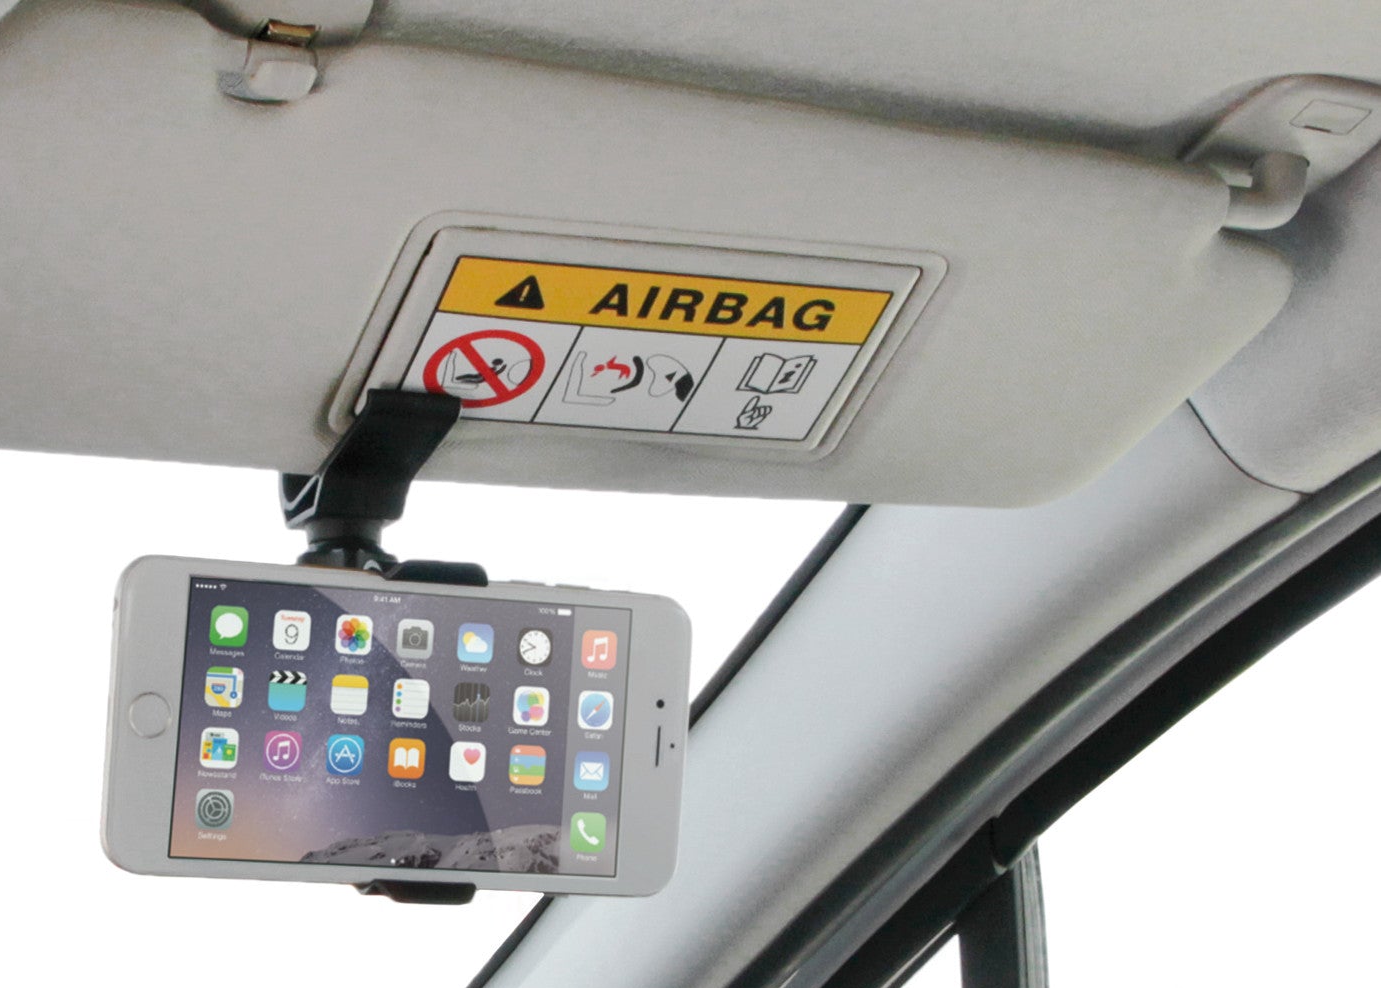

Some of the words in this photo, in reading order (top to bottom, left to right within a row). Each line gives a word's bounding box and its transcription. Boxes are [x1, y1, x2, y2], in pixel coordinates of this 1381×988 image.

[589, 282, 837, 332] AIRBAG
[284, 623, 299, 645] 9
[209, 647, 245, 659] Messages
[274, 651, 305, 661] Calendar
[338, 656, 365, 665] Photos
[400, 660, 427, 669] Camera
[459, 664, 488, 672] Weather
[523, 668, 543, 677] Clock
[587, 671, 608, 680] Music
[212, 709, 232, 719] Maps
[273, 713, 298, 722] Videos
[458, 724, 482, 733] Stocks
[507, 726, 528, 735] Game
[529, 728, 552, 737] Center
[259, 772, 282, 782] iTunes
[283, 774, 303, 783] Store
[325, 776, 342, 786] App
[342, 777, 360, 786] Store
[509, 785, 543, 795] Passbook
[583, 792, 598, 800] Mail
[197, 831, 227, 841] Settings
